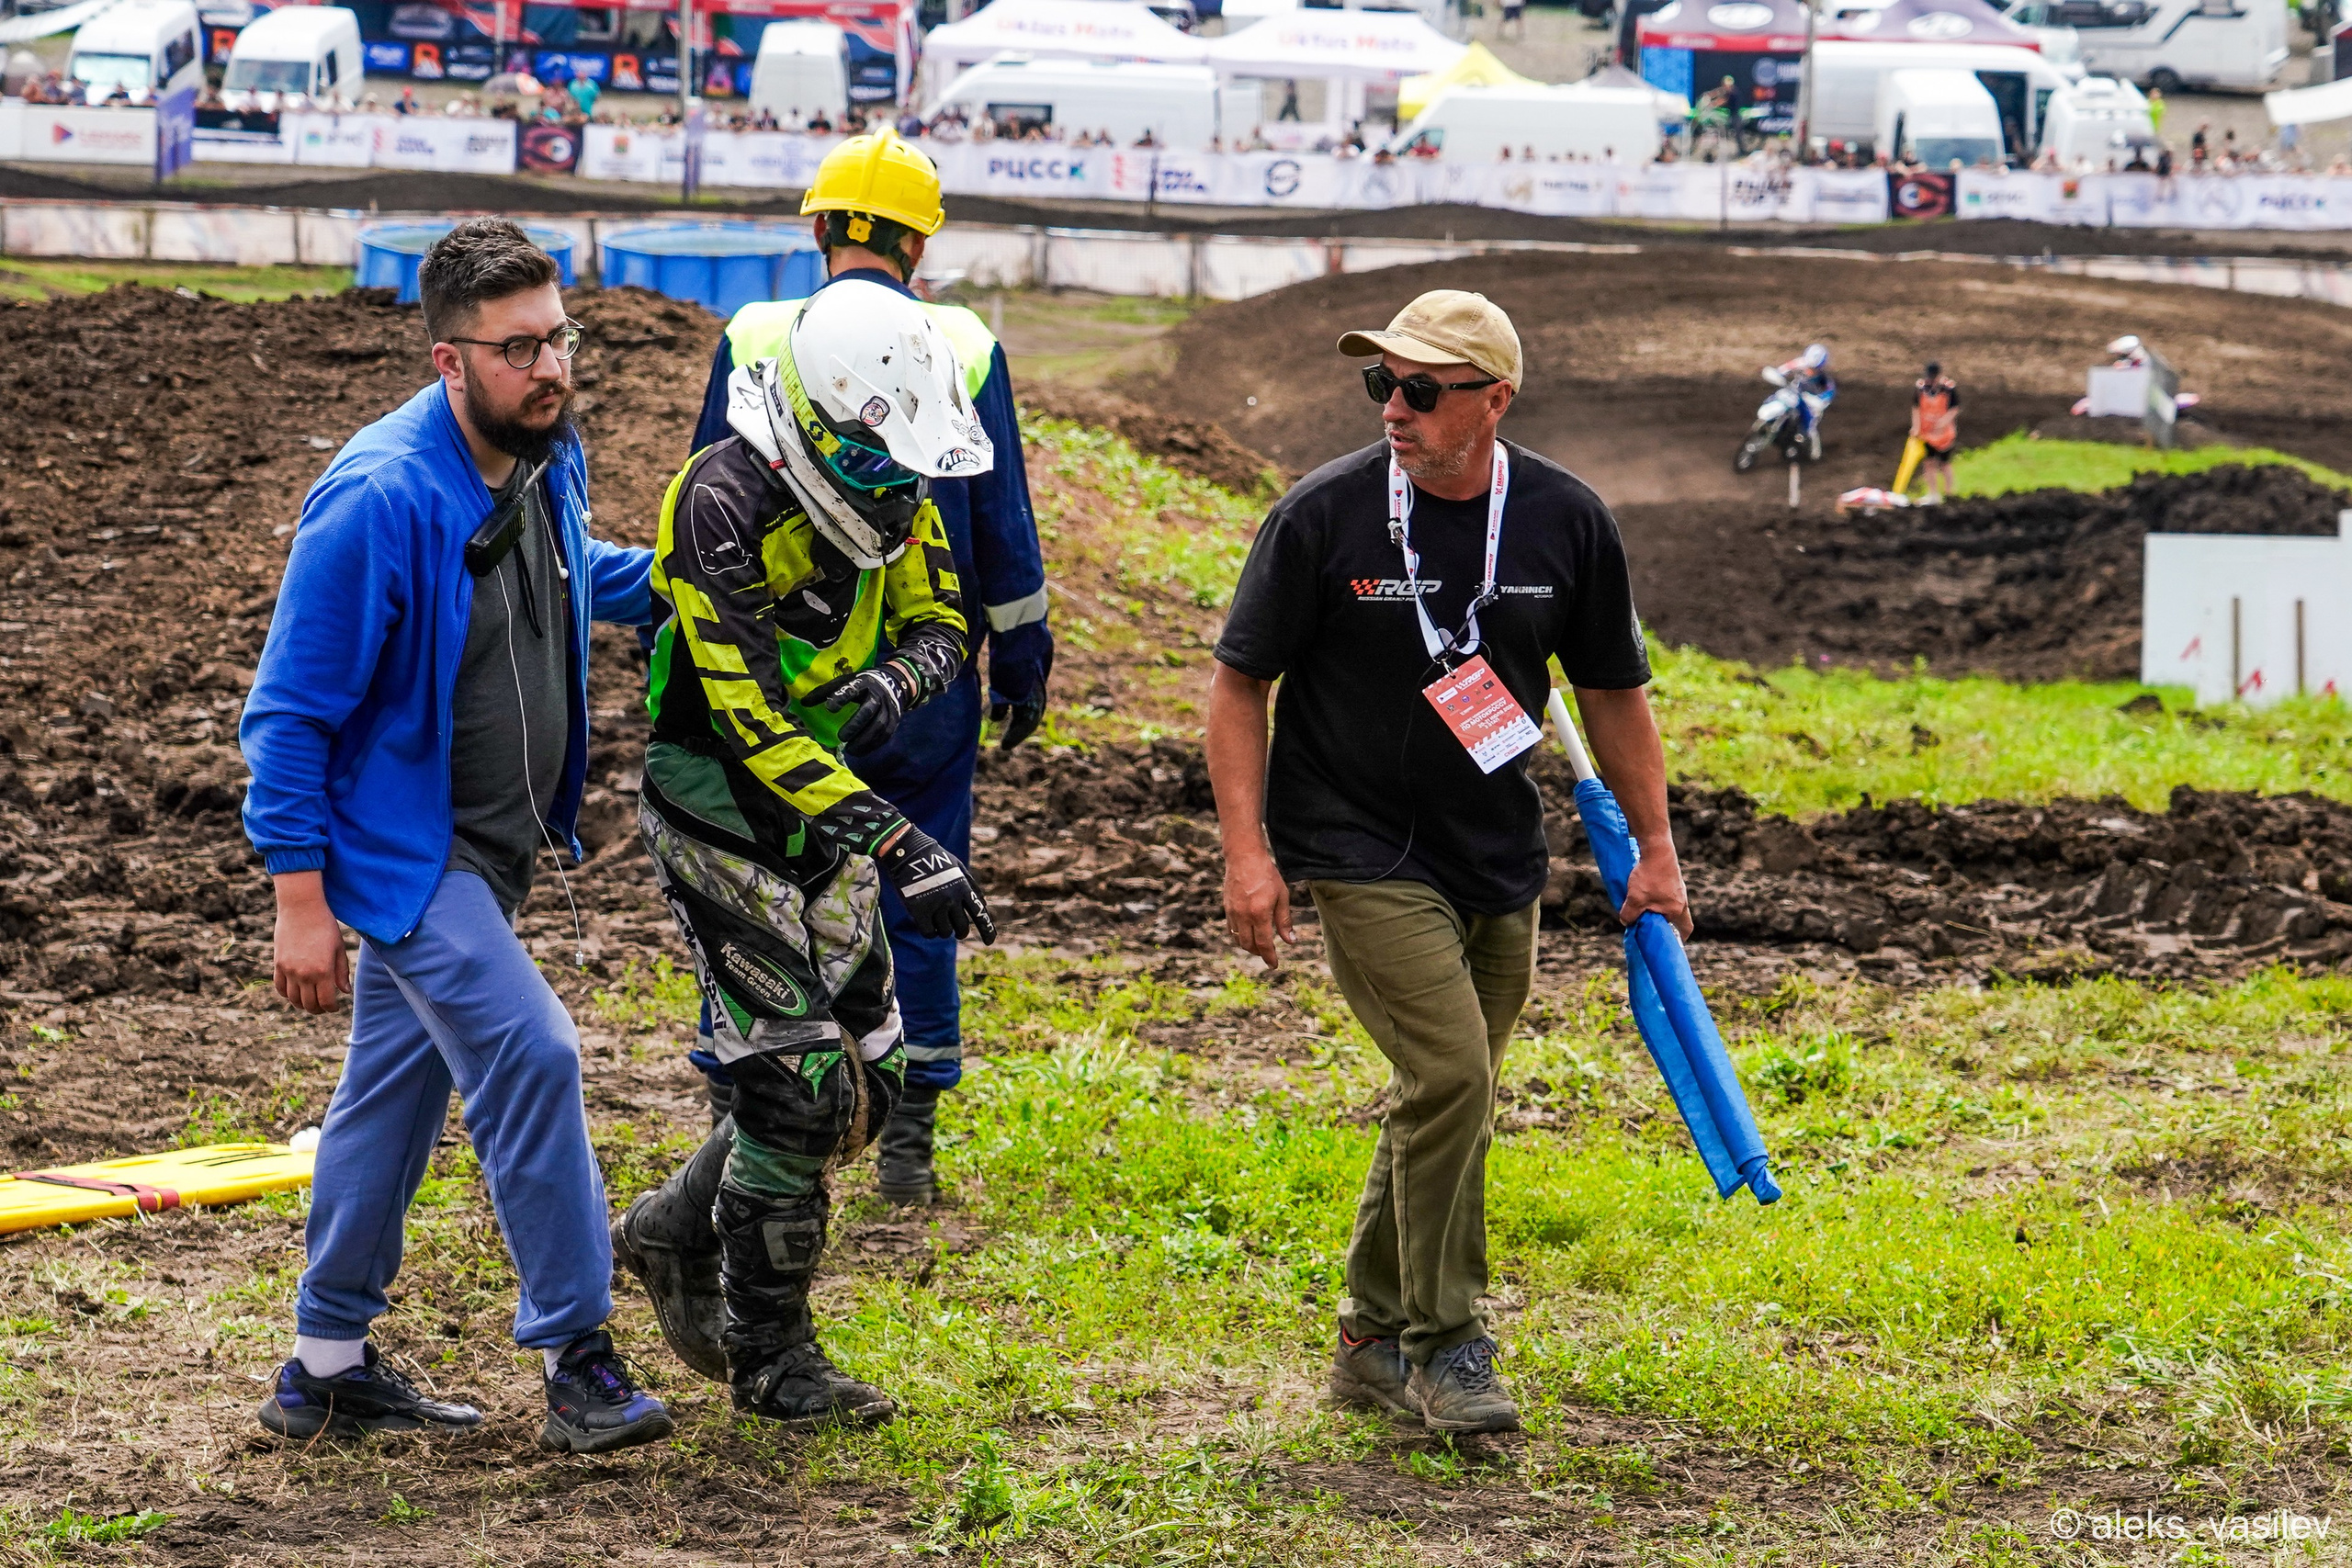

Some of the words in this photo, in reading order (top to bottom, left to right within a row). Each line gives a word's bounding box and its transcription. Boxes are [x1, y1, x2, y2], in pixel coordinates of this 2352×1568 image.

[988, 158, 1085, 181] РЦССК
[1374, 580, 1442, 595] RGP
[1461, 722, 1471, 731] ПО
[1469, 699, 1507, 726] МОТОКРОССУ
[720, 942, 790, 999] Kawasaki
[724, 960, 747, 979] Team
[746, 976, 772, 998] Green
